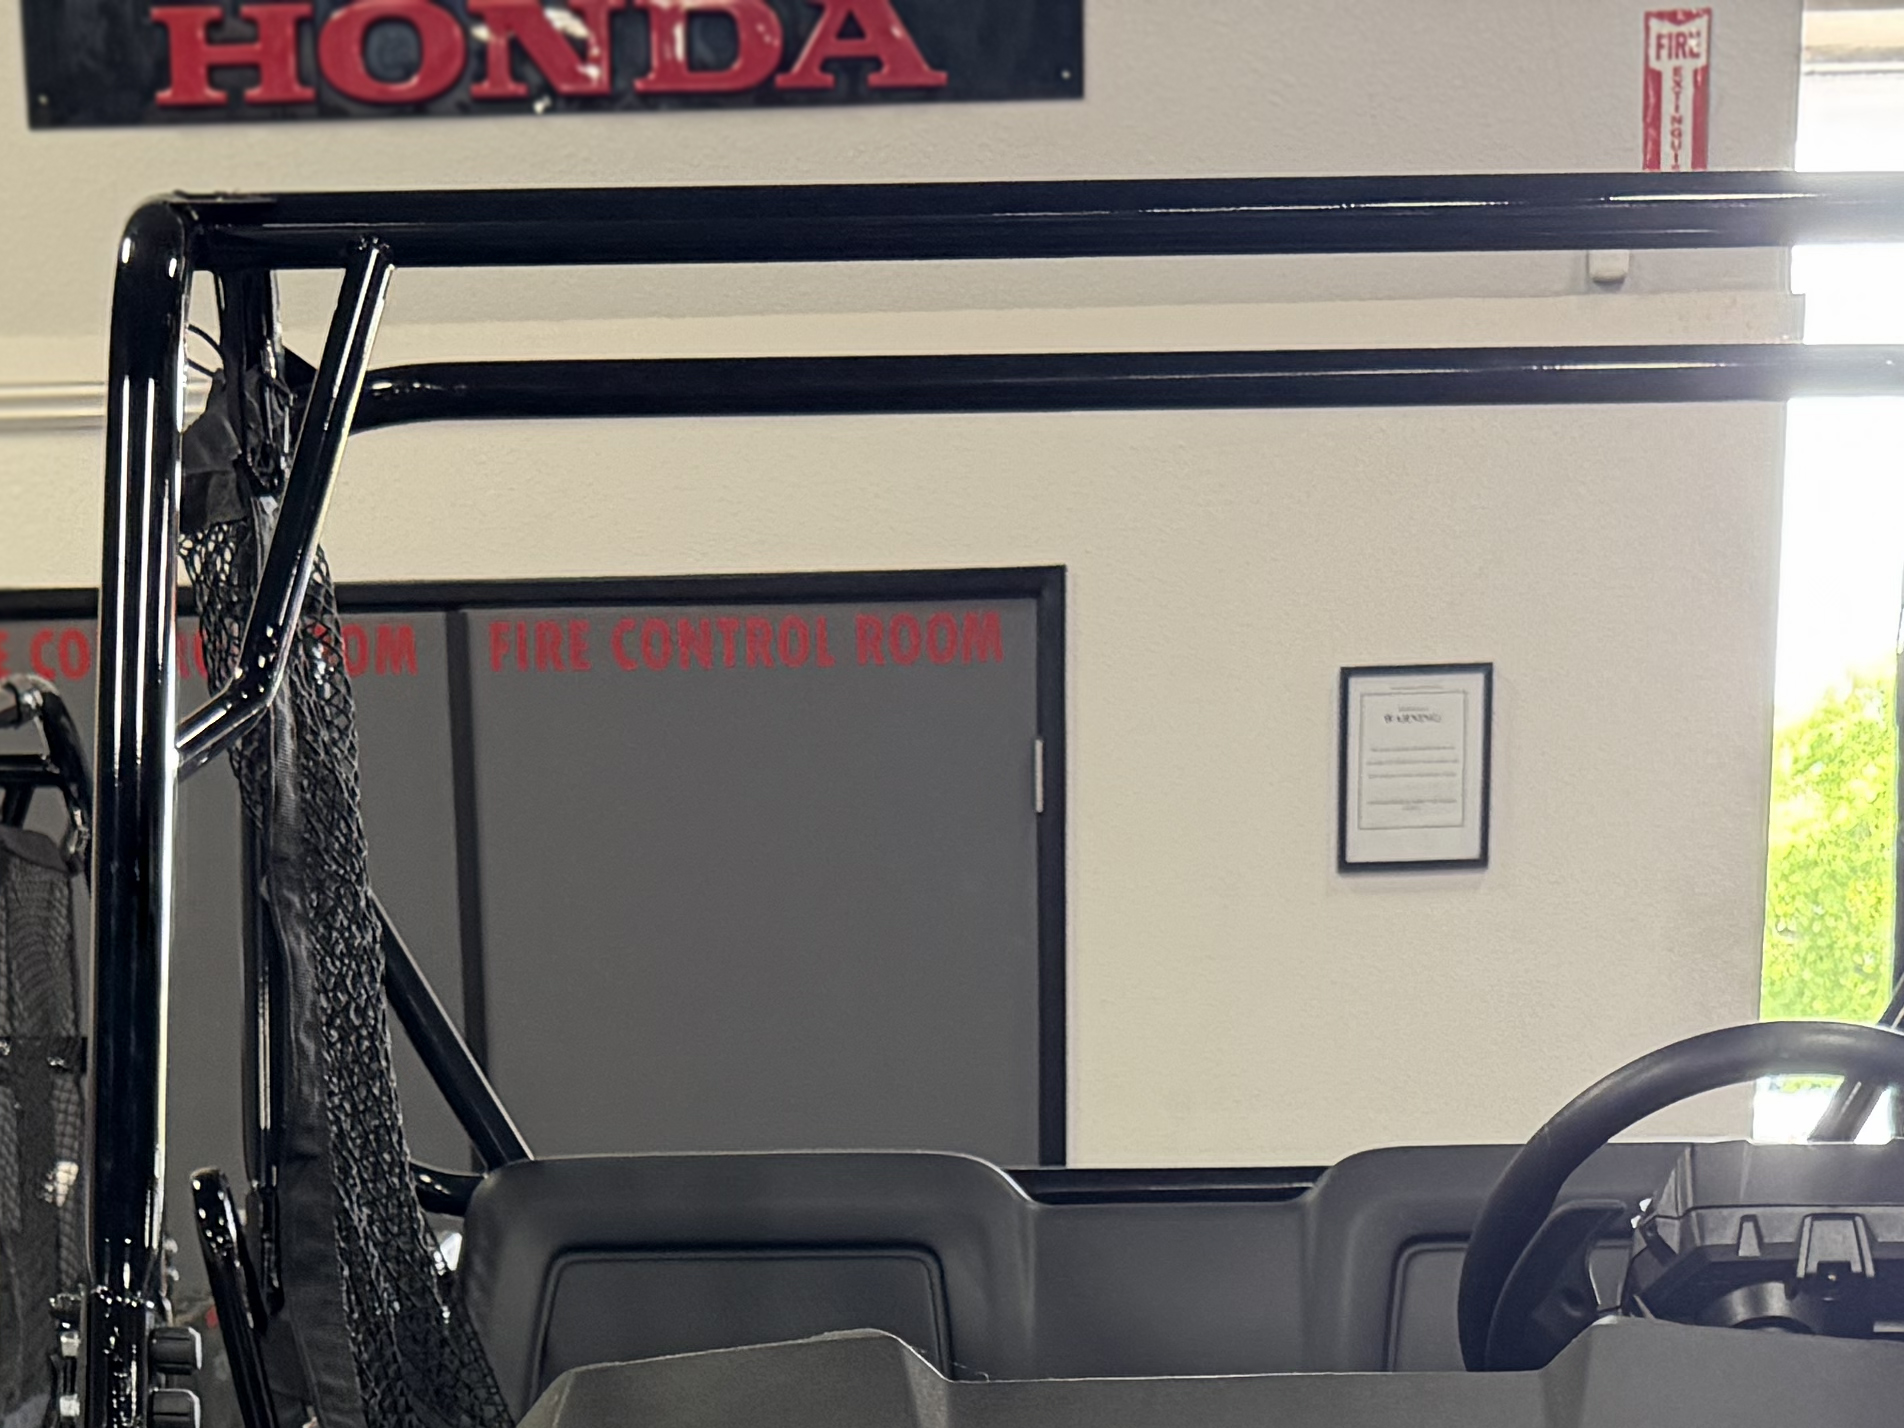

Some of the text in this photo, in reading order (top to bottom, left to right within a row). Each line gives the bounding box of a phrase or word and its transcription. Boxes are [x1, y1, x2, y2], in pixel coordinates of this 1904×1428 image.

[150, 0, 948, 106] HONDA
[488, 610, 1005, 672] FIRE CONTROL ROOM
